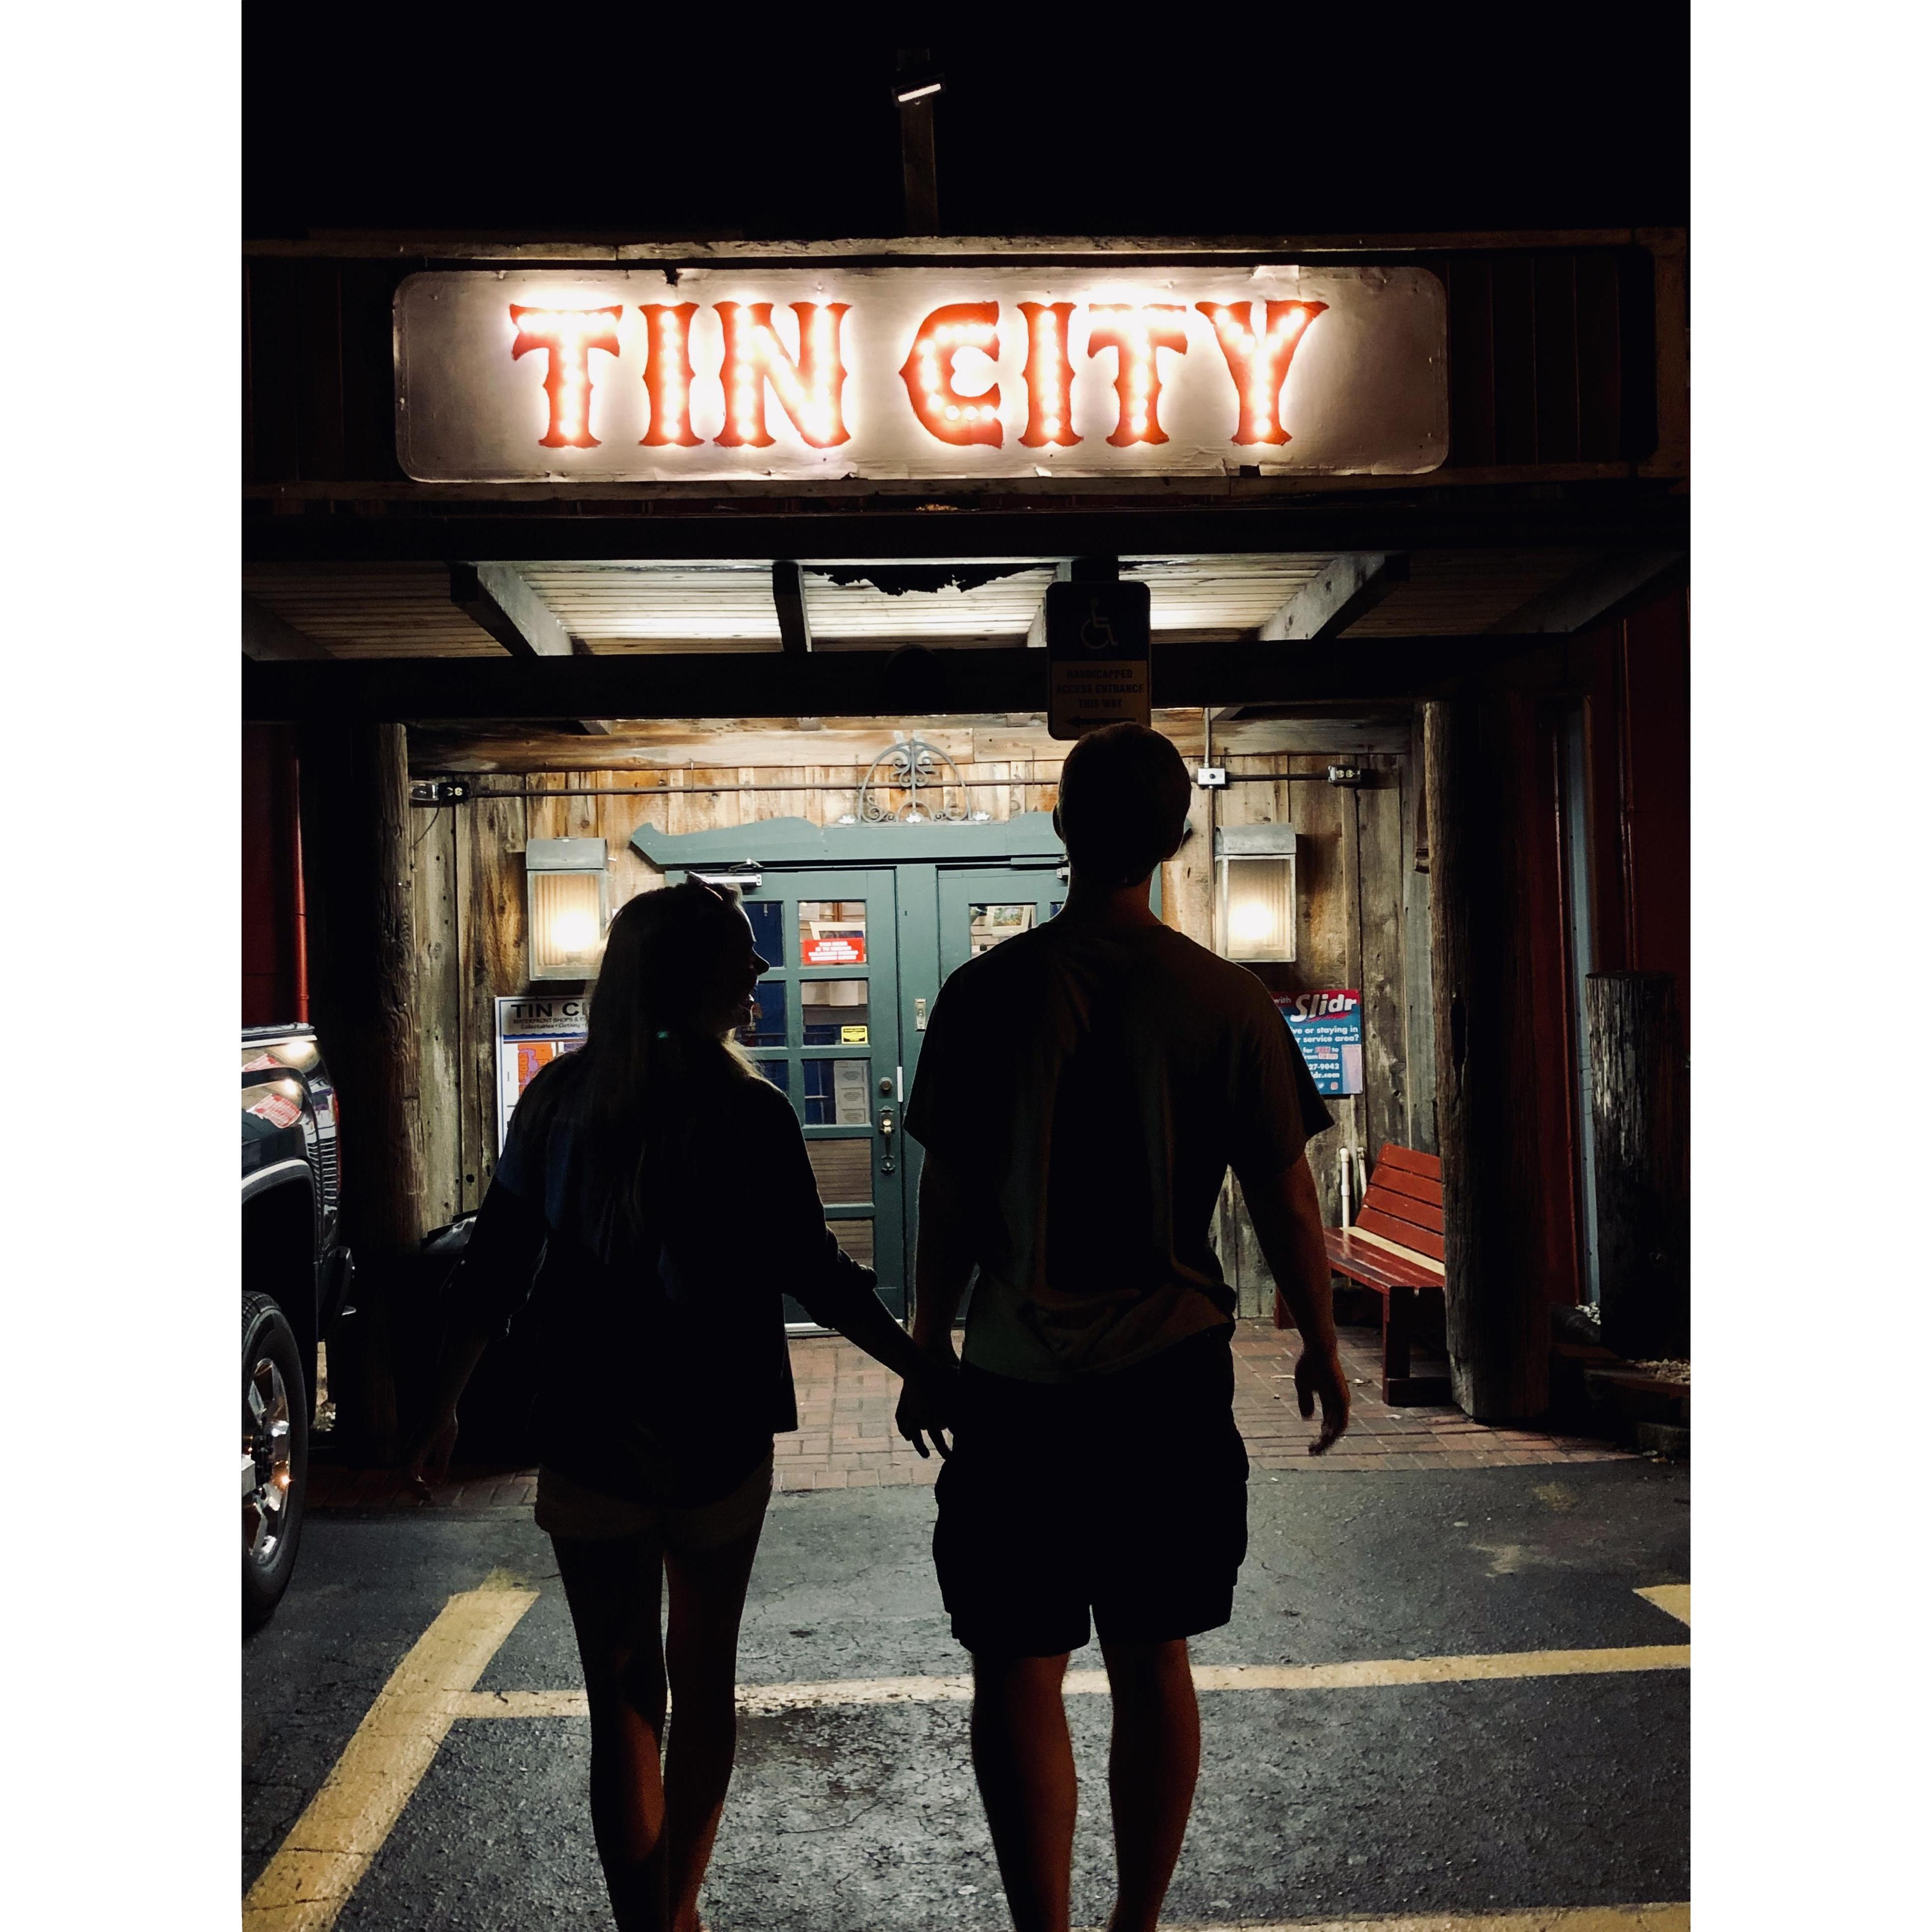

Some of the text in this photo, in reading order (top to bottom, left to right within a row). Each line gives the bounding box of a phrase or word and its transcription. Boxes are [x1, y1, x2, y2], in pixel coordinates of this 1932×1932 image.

[508, 301, 1329, 450] TIN CITY
[1067, 669, 1133, 679] HANDICAPPED
[1057, 684, 1144, 694] ACCESS ENTRANCE
[1079, 699, 1123, 708] THIS WAY
[510, 1003, 552, 1018] TIN
[1290, 994, 1357, 1022] Slidr
[1317, 1026, 1348, 1035] staying
[1303, 1035, 1333, 1043] service
[1334, 1034, 1359, 1042] area?
